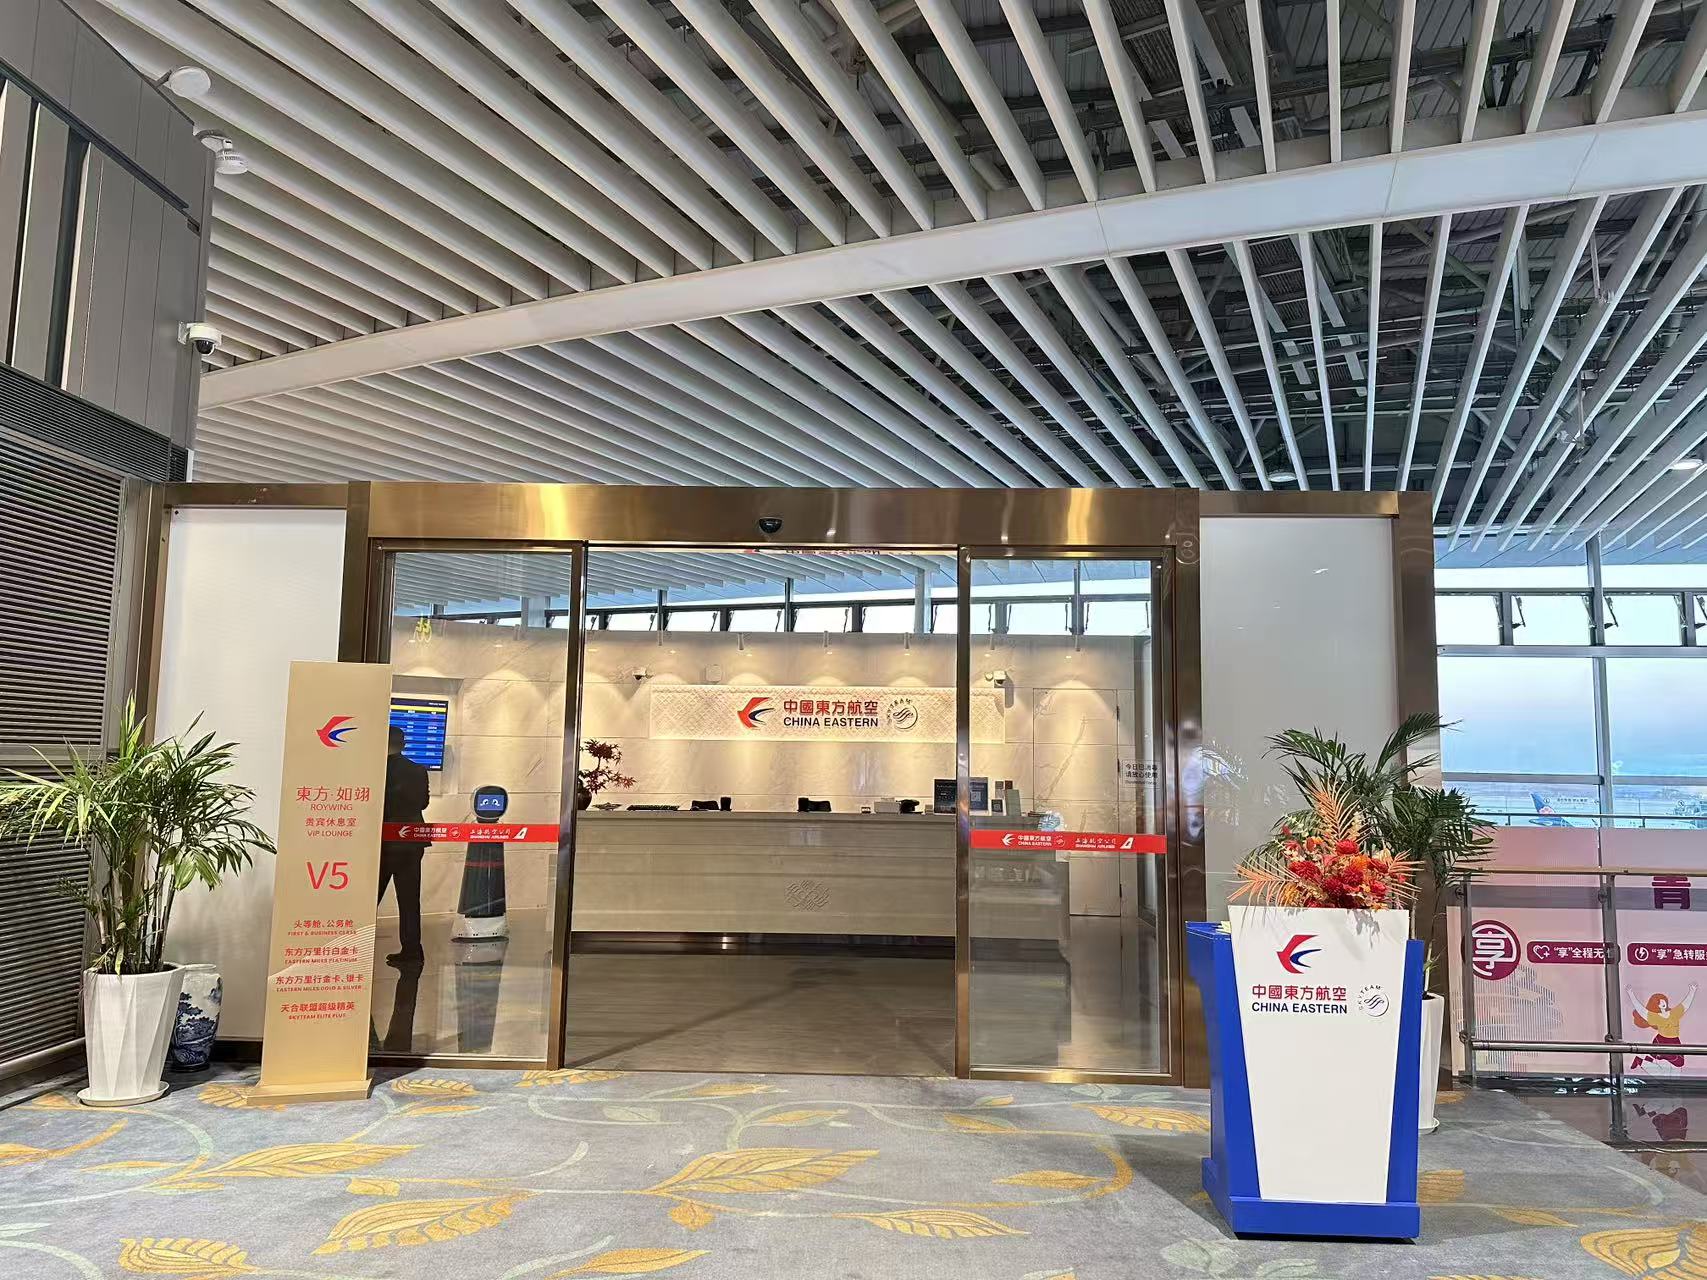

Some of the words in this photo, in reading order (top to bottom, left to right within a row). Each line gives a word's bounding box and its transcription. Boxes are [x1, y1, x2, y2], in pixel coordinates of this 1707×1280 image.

[783, 699, 878, 716] 中國東方航空
[783, 716, 820, 727] CHINA
[824, 717, 879, 728] EASTERN
[310, 803, 353, 811] ROYWING
[305, 817, 357, 827] 贵宾休息室
[306, 861, 351, 890] V5
[293, 919, 354, 929] 头等舱、公务舱
[284, 946, 359, 957] 东方万里行白金卡
[1651, 948, 1707, 961] “享”急转服
[275, 974, 365, 985] 东方万里行金卡、银卡
[1251, 984, 1347, 1001] 中國東方航空
[280, 1001, 356, 1013] 天合联盟超级精英
[1251, 1002, 1289, 1013] CHINA
[1292, 1003, 1348, 1014] EASTERN
